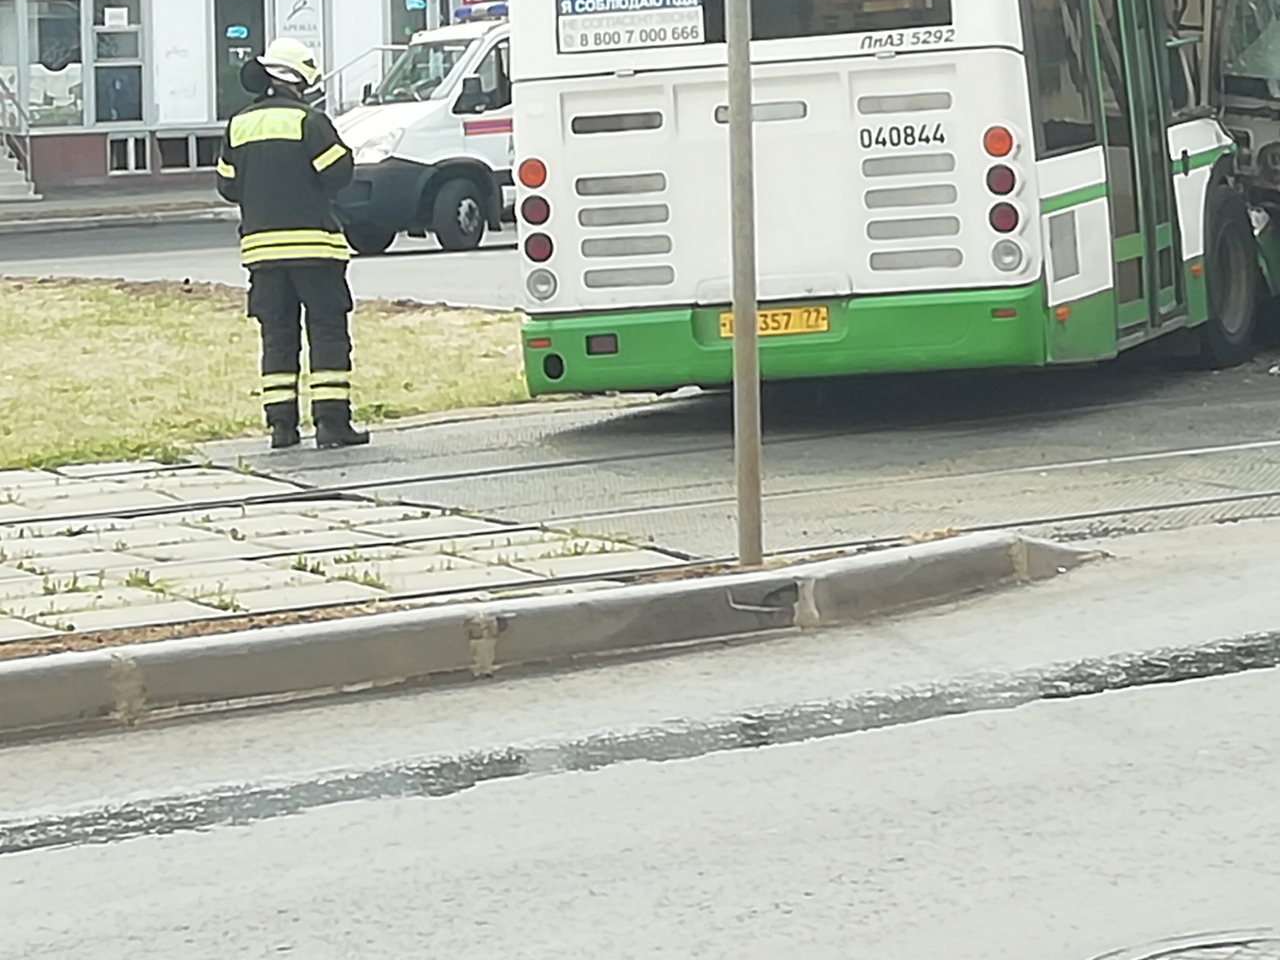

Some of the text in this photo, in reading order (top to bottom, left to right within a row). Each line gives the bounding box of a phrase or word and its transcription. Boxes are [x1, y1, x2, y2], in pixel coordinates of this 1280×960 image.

[561, 0, 572, 14] Я
[580, 25, 699, 47] 8 800 7 000 666
[911, 29, 955, 45] 5292
[860, 123, 945, 148] 040844
